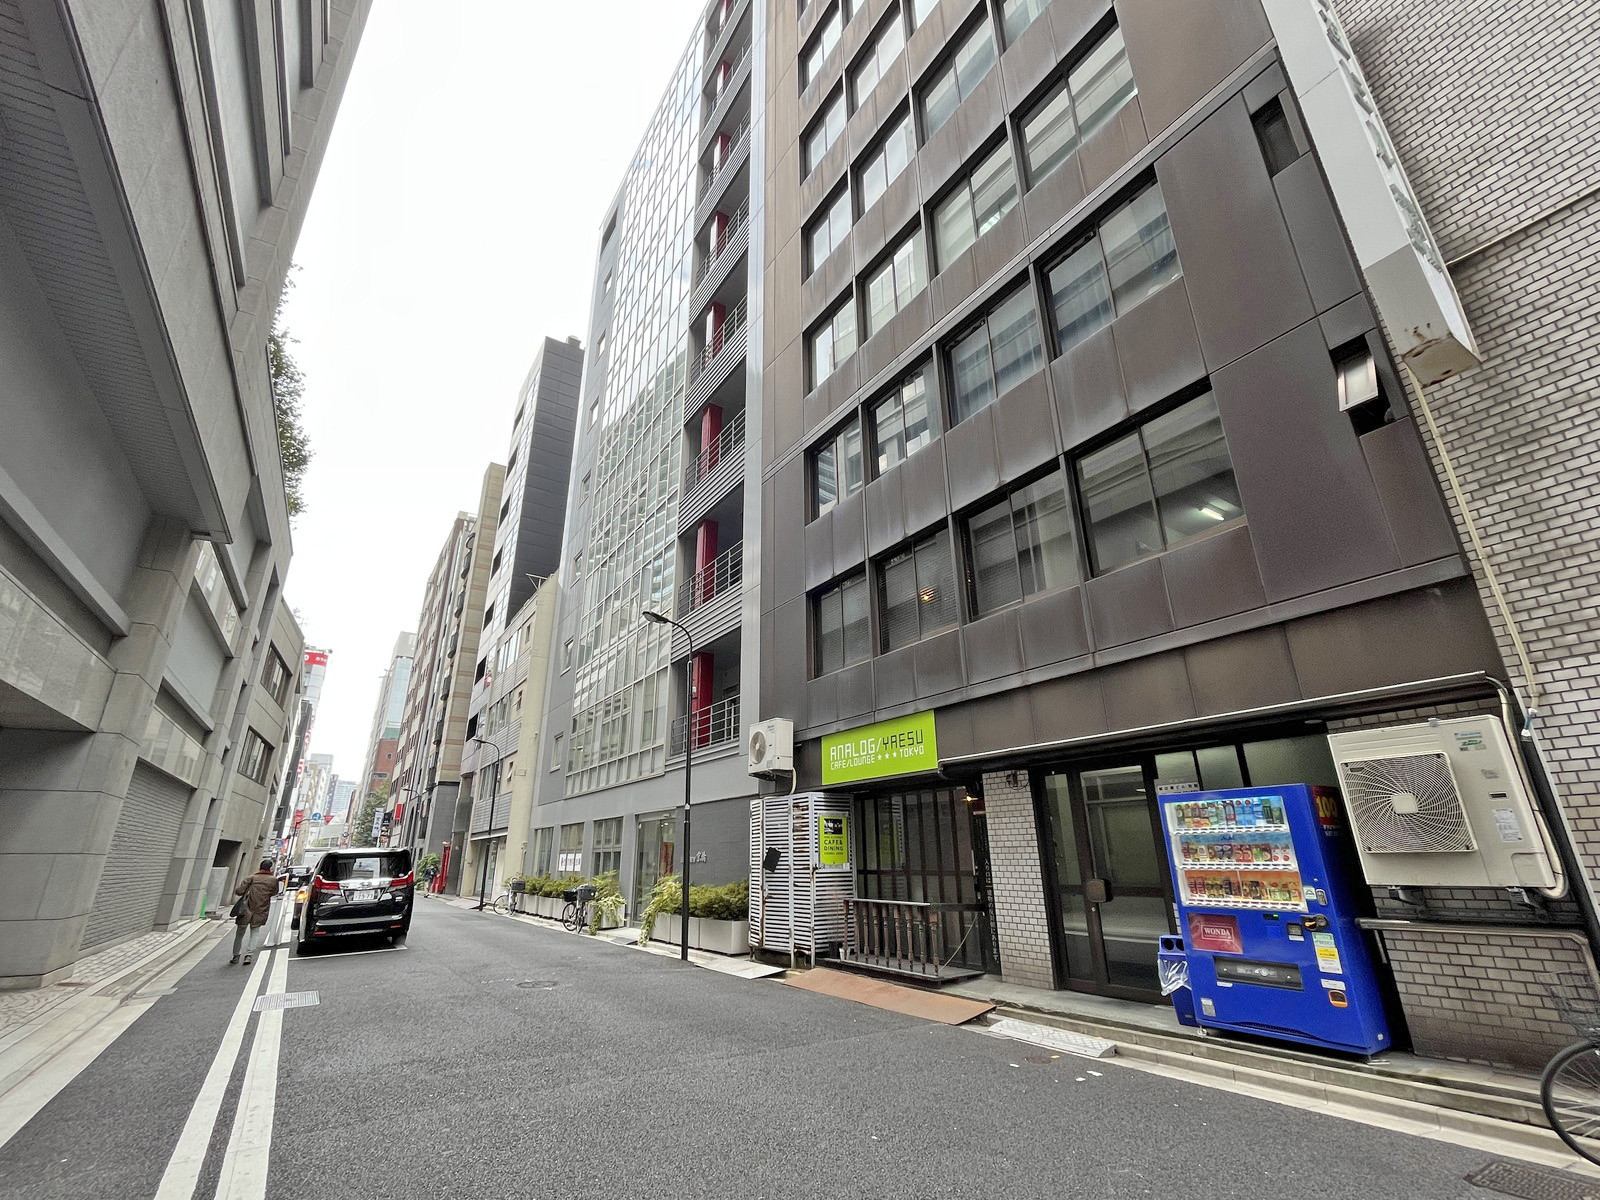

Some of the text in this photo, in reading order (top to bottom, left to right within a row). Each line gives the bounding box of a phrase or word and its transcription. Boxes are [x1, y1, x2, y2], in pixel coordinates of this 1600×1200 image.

[830, 729, 923, 761] ANALOG/YAESU
[830, 745, 924, 770] CAFE/LOUNGE TOKYO
[1316, 795, 1338, 817] 100
[1203, 927, 1231, 936] WONDA
